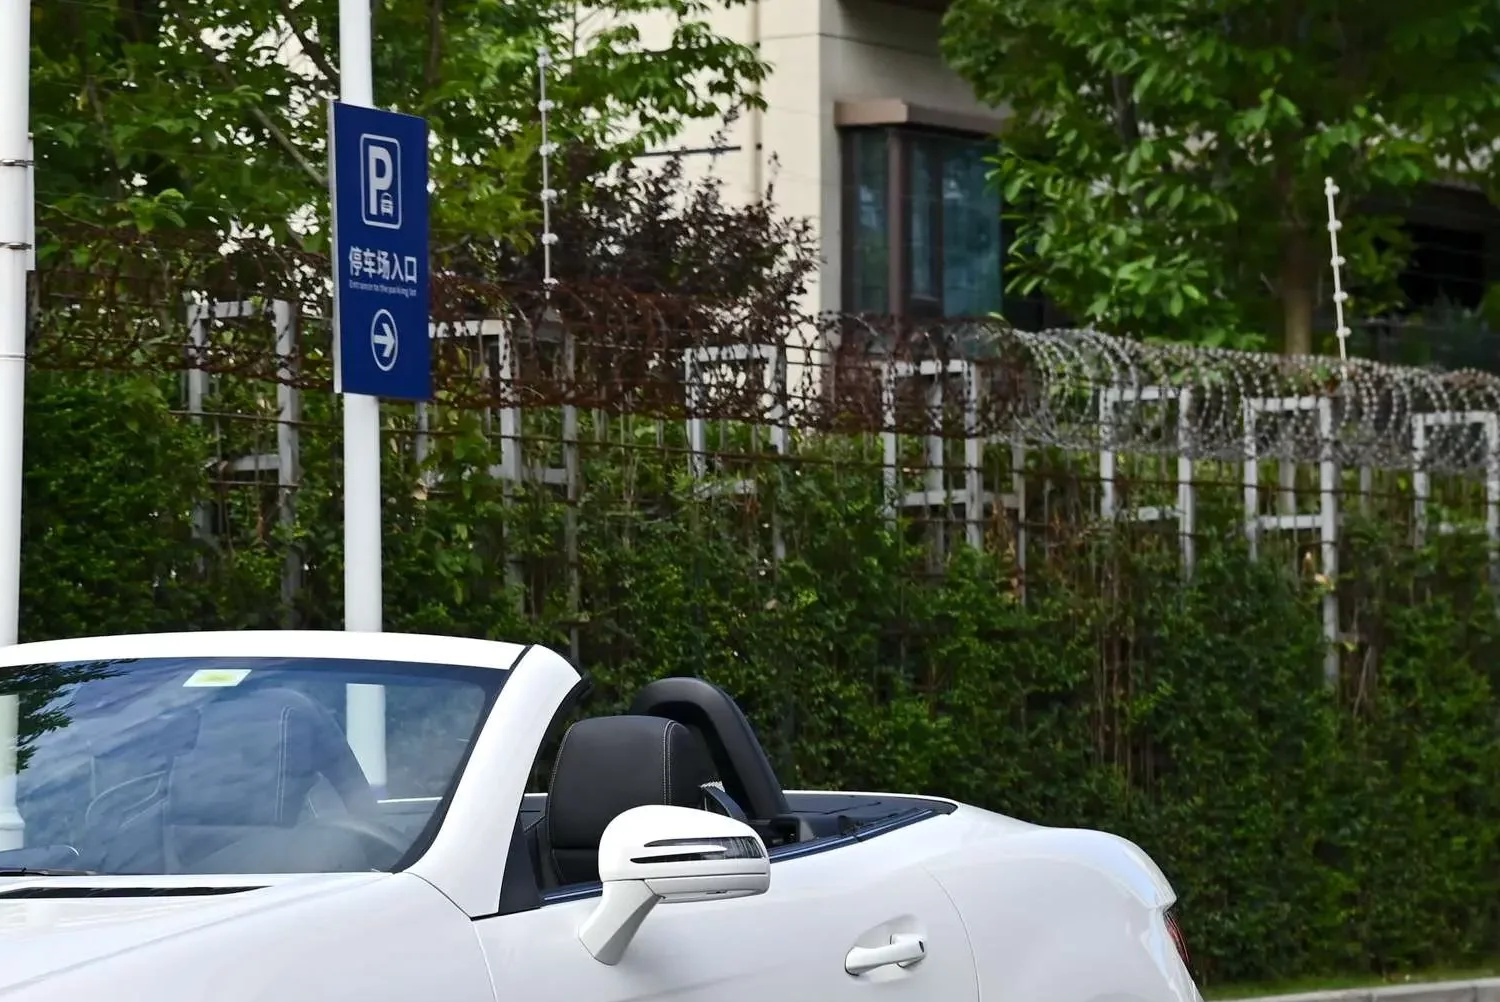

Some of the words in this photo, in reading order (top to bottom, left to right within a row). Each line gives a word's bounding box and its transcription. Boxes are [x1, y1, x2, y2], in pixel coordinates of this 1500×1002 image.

[368, 144, 393, 216] P
[348, 245, 417, 284] 停车场入口
